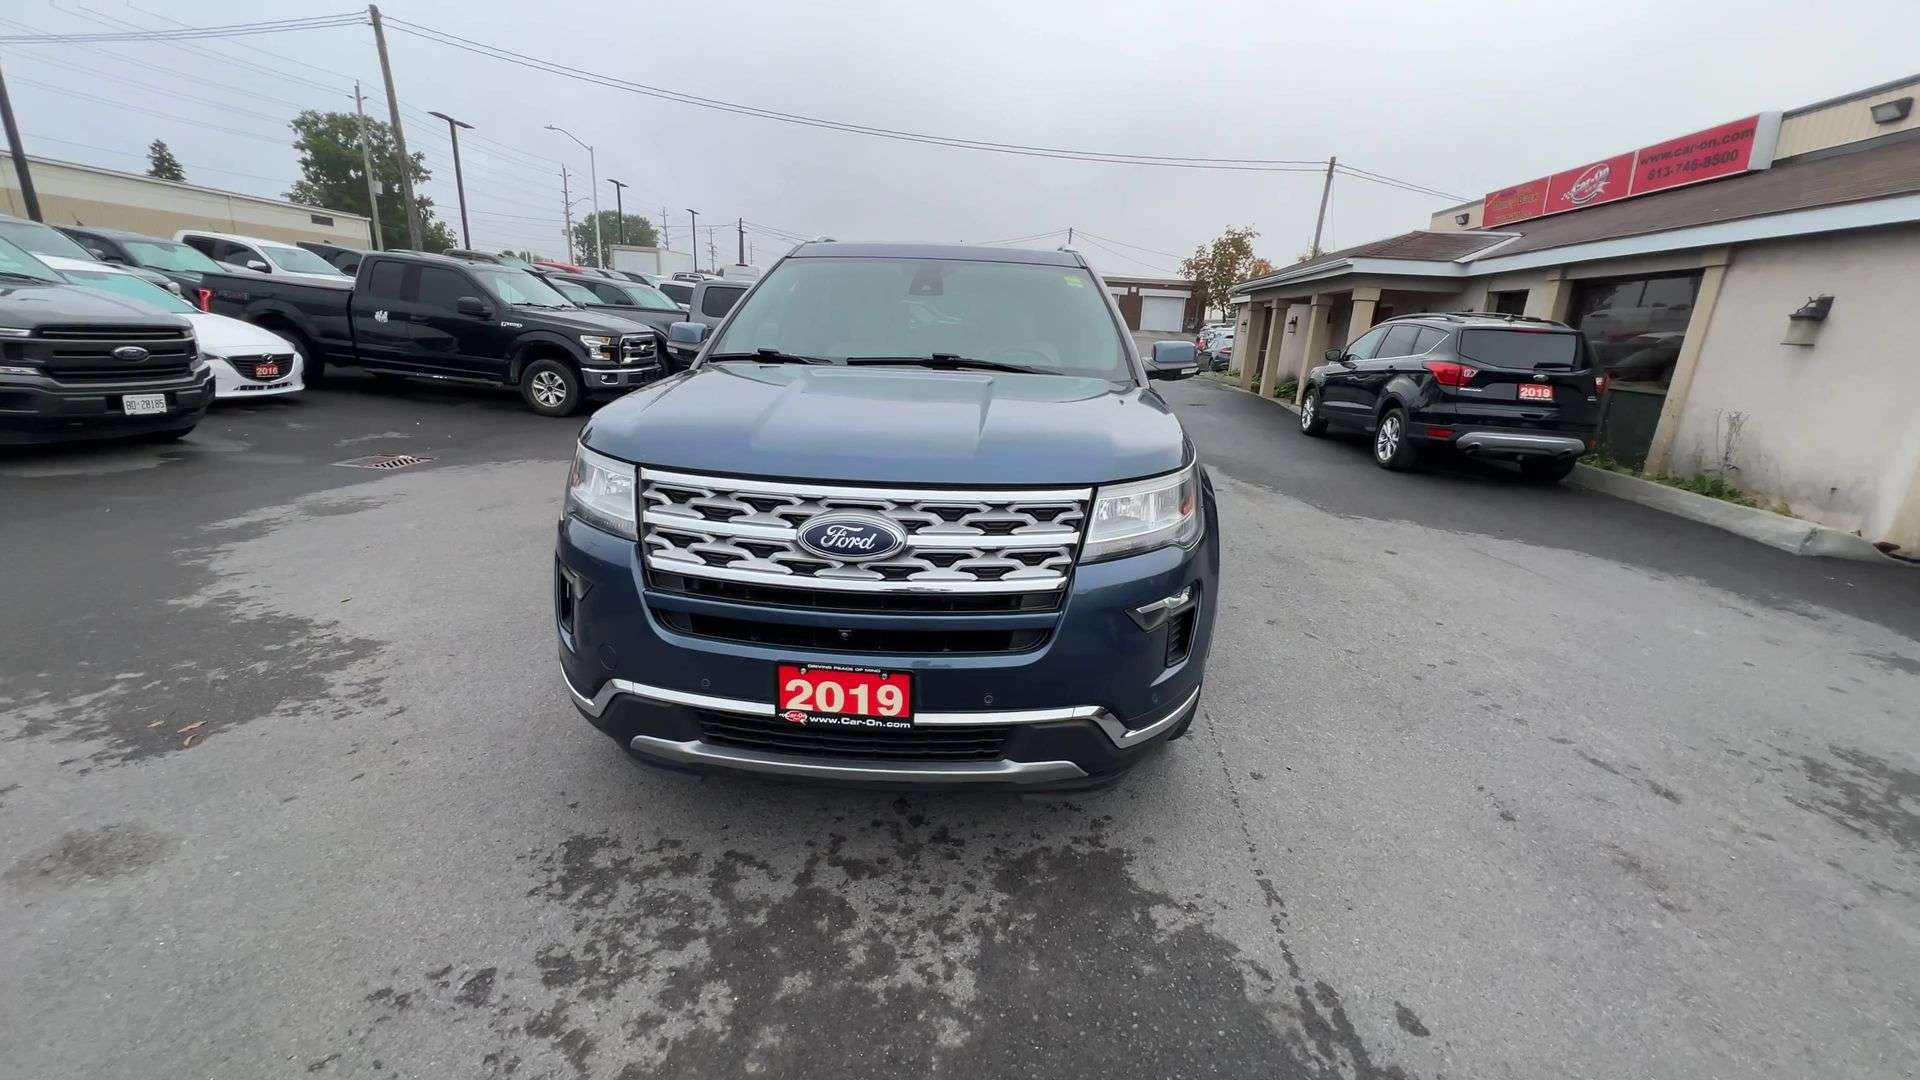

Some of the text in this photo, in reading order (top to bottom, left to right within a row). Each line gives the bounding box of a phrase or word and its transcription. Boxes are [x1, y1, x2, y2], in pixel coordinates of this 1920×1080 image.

[256, 367, 278, 375] 2016
[1520, 387, 1551, 398] 2019
[820, 524, 878, 550] Ford
[785, 678, 903, 717] 2019
[809, 715, 911, 729] www.Car-On.com
